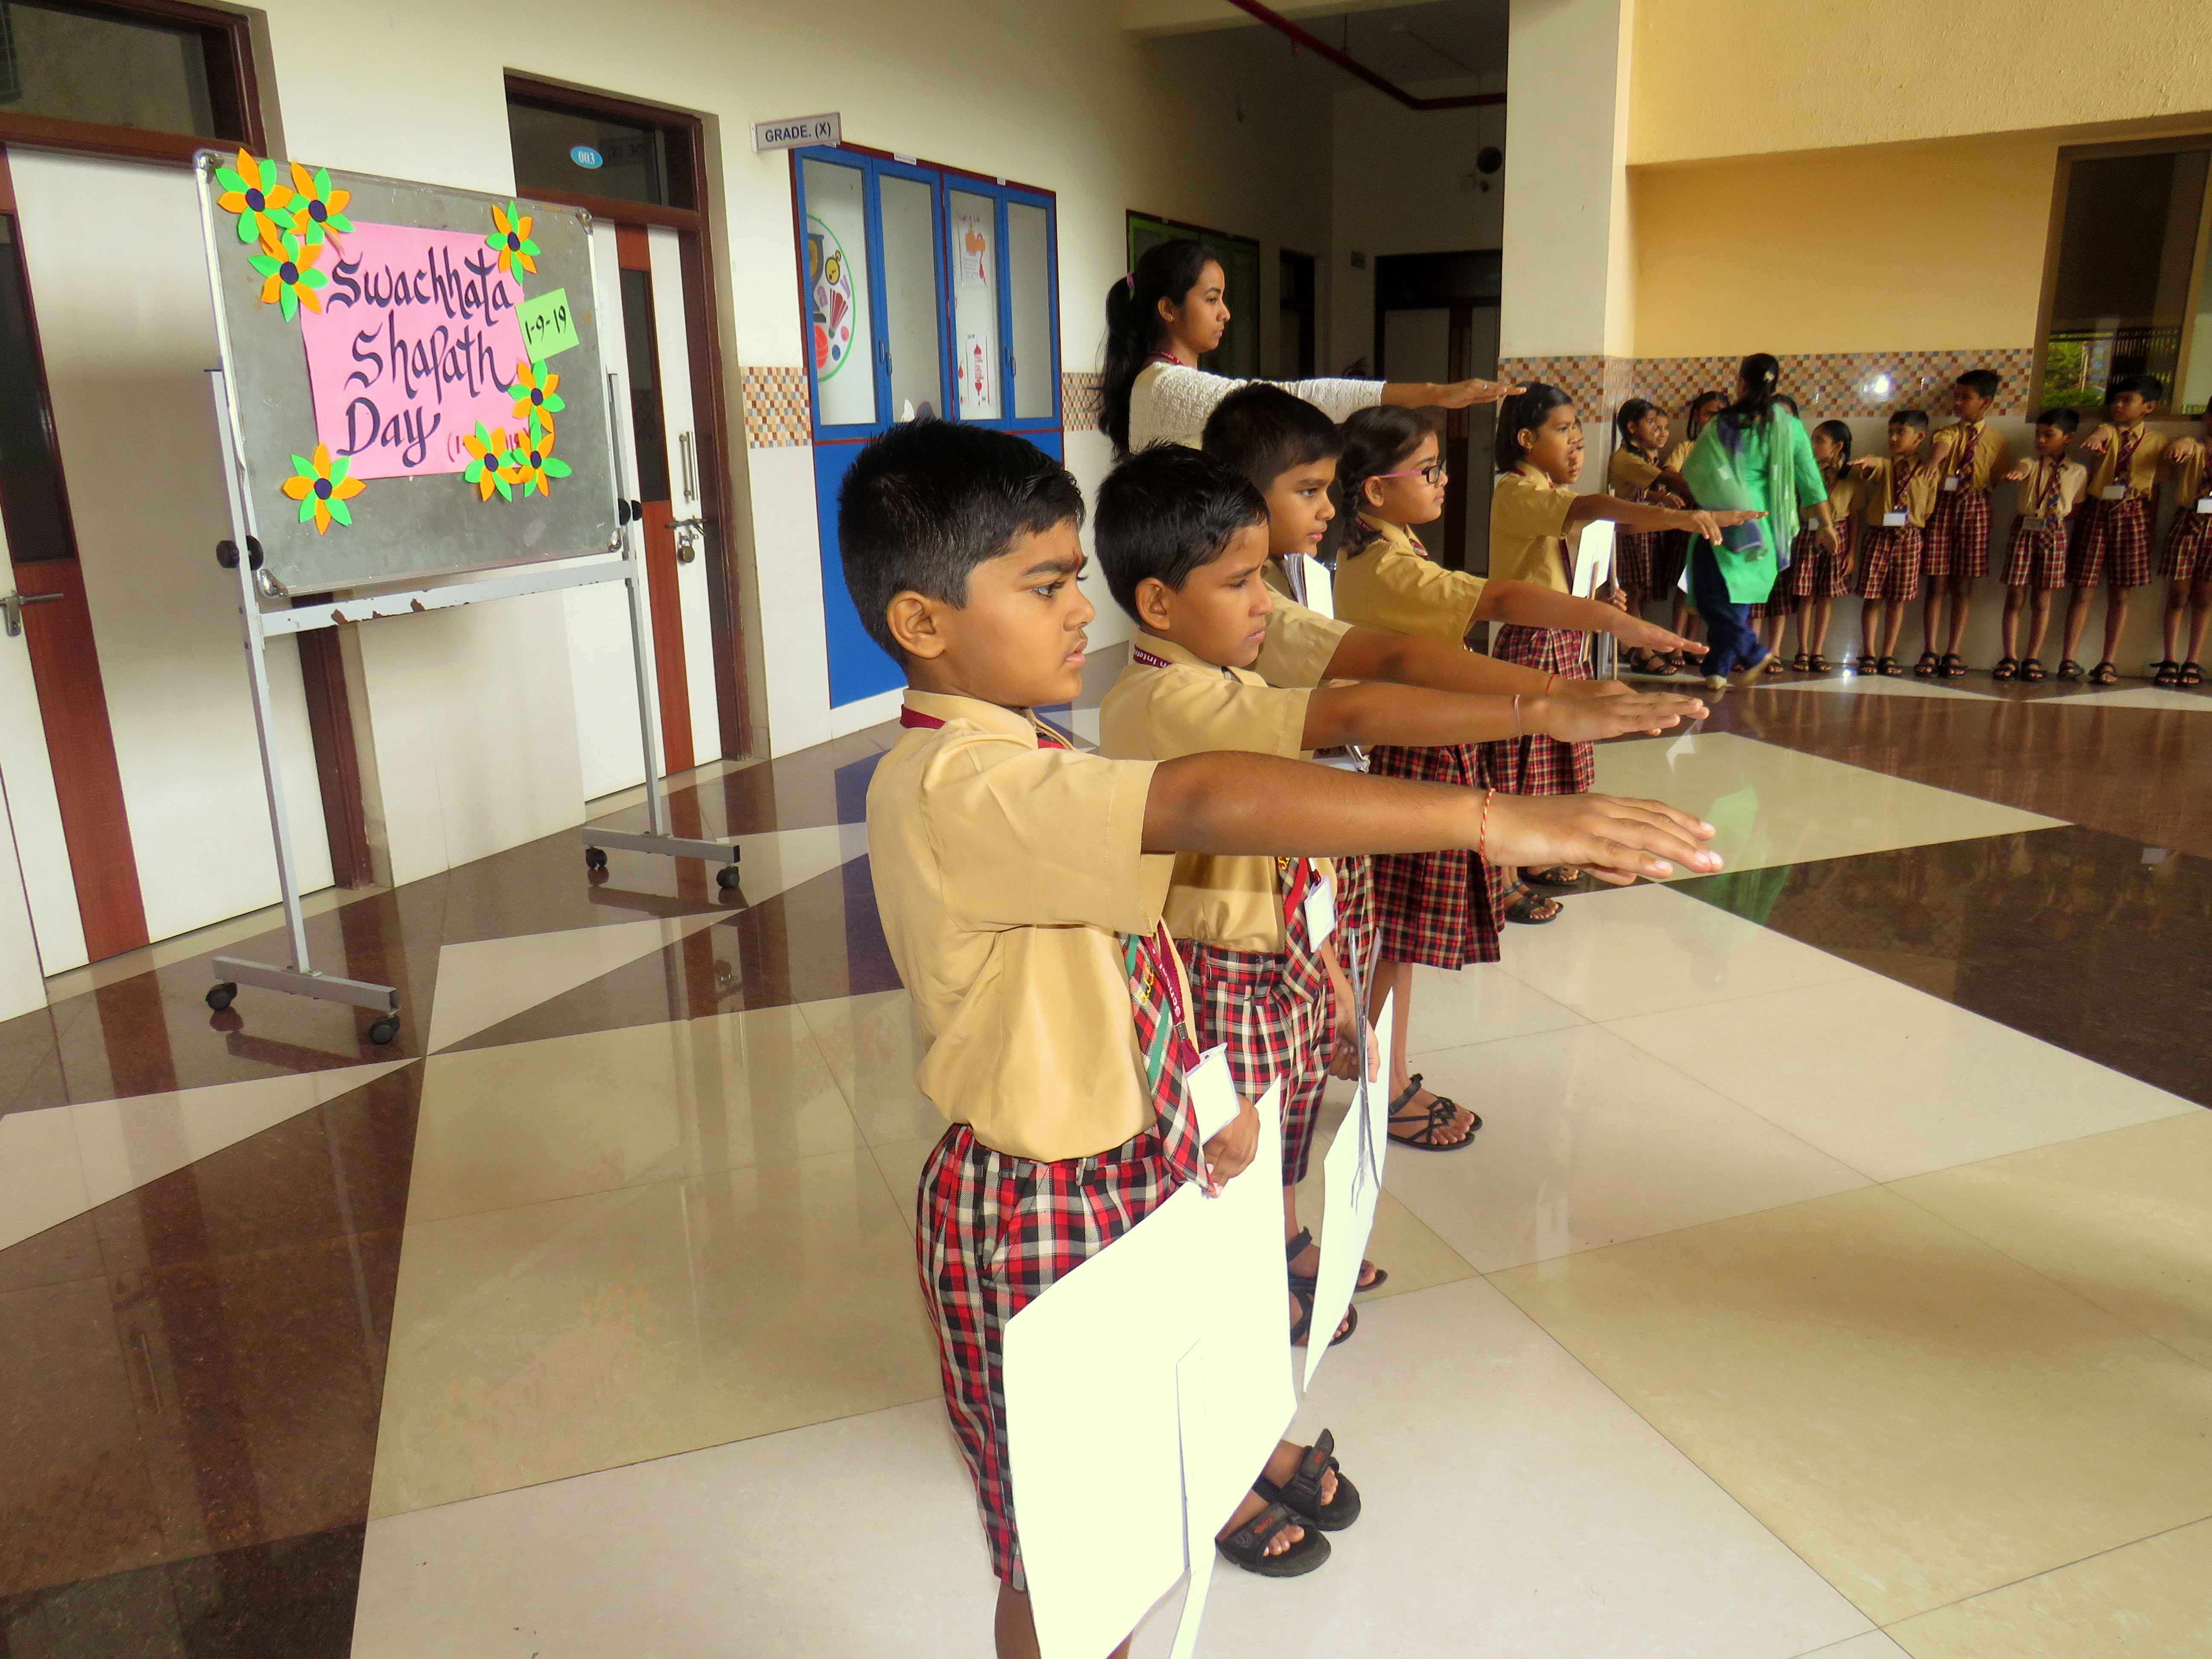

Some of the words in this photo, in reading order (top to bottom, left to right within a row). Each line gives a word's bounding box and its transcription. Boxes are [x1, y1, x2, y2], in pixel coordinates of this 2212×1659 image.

[765, 125, 811, 143] GRADE.
[815, 122, 831, 140] (X)
[326, 245, 514, 327] Swachhata
[343, 309, 516, 405] Shapath
[525, 305, 566, 345] 1-9-19
[336, 397, 441, 468] Day
